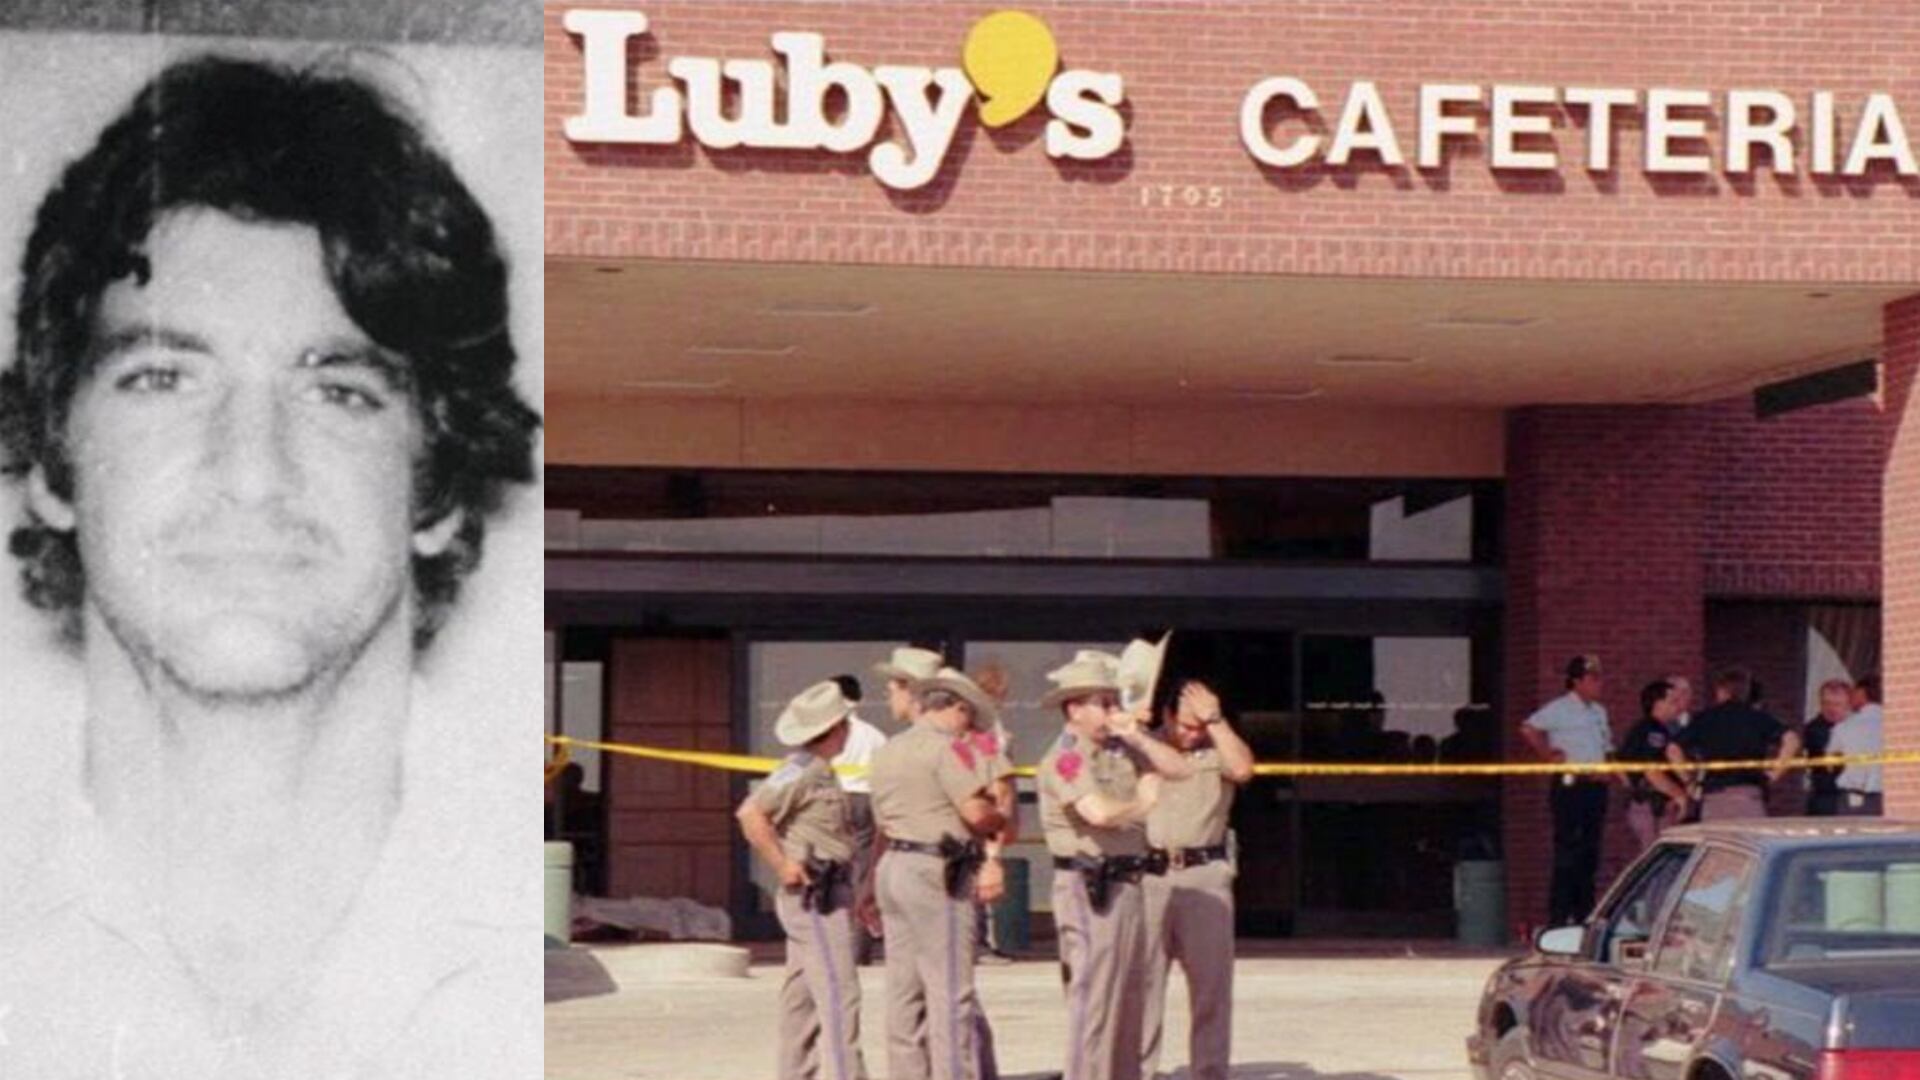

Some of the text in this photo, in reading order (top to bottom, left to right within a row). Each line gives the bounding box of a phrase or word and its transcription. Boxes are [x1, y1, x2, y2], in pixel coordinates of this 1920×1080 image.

[563, 9, 1920, 189] Luby's CAFETERIA
[1140, 185, 1223, 208] 1705
